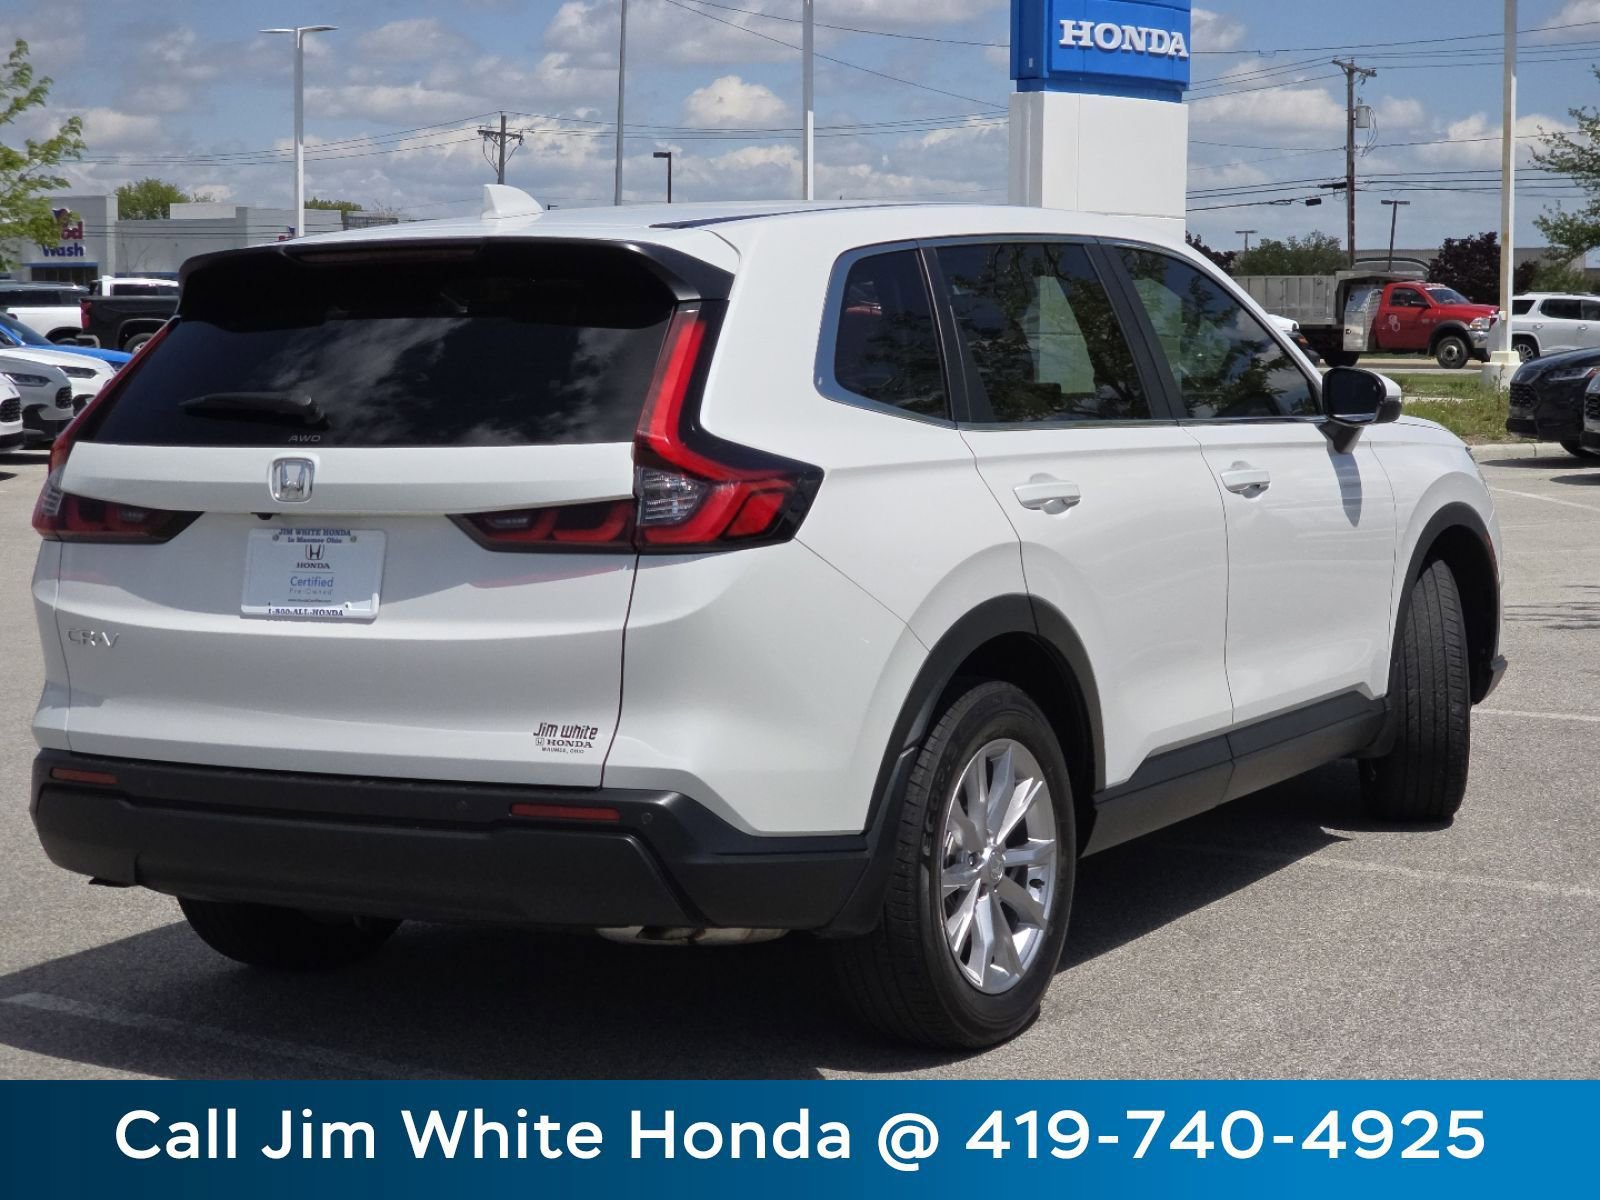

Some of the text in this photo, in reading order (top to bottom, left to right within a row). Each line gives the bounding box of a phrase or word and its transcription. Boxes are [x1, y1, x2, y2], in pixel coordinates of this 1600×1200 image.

[1059, 19, 1189, 57] HONDA
[288, 434, 321, 442] AWD
[278, 528, 352, 537] JIM WHITE HONDA
[296, 562, 331, 570] HONDA
[290, 576, 334, 588] Certified
[268, 608, 344, 617] 1-800-ALL-HONDA
[533, 722, 559, 738] Jim
[546, 738, 593, 748] HONDA
